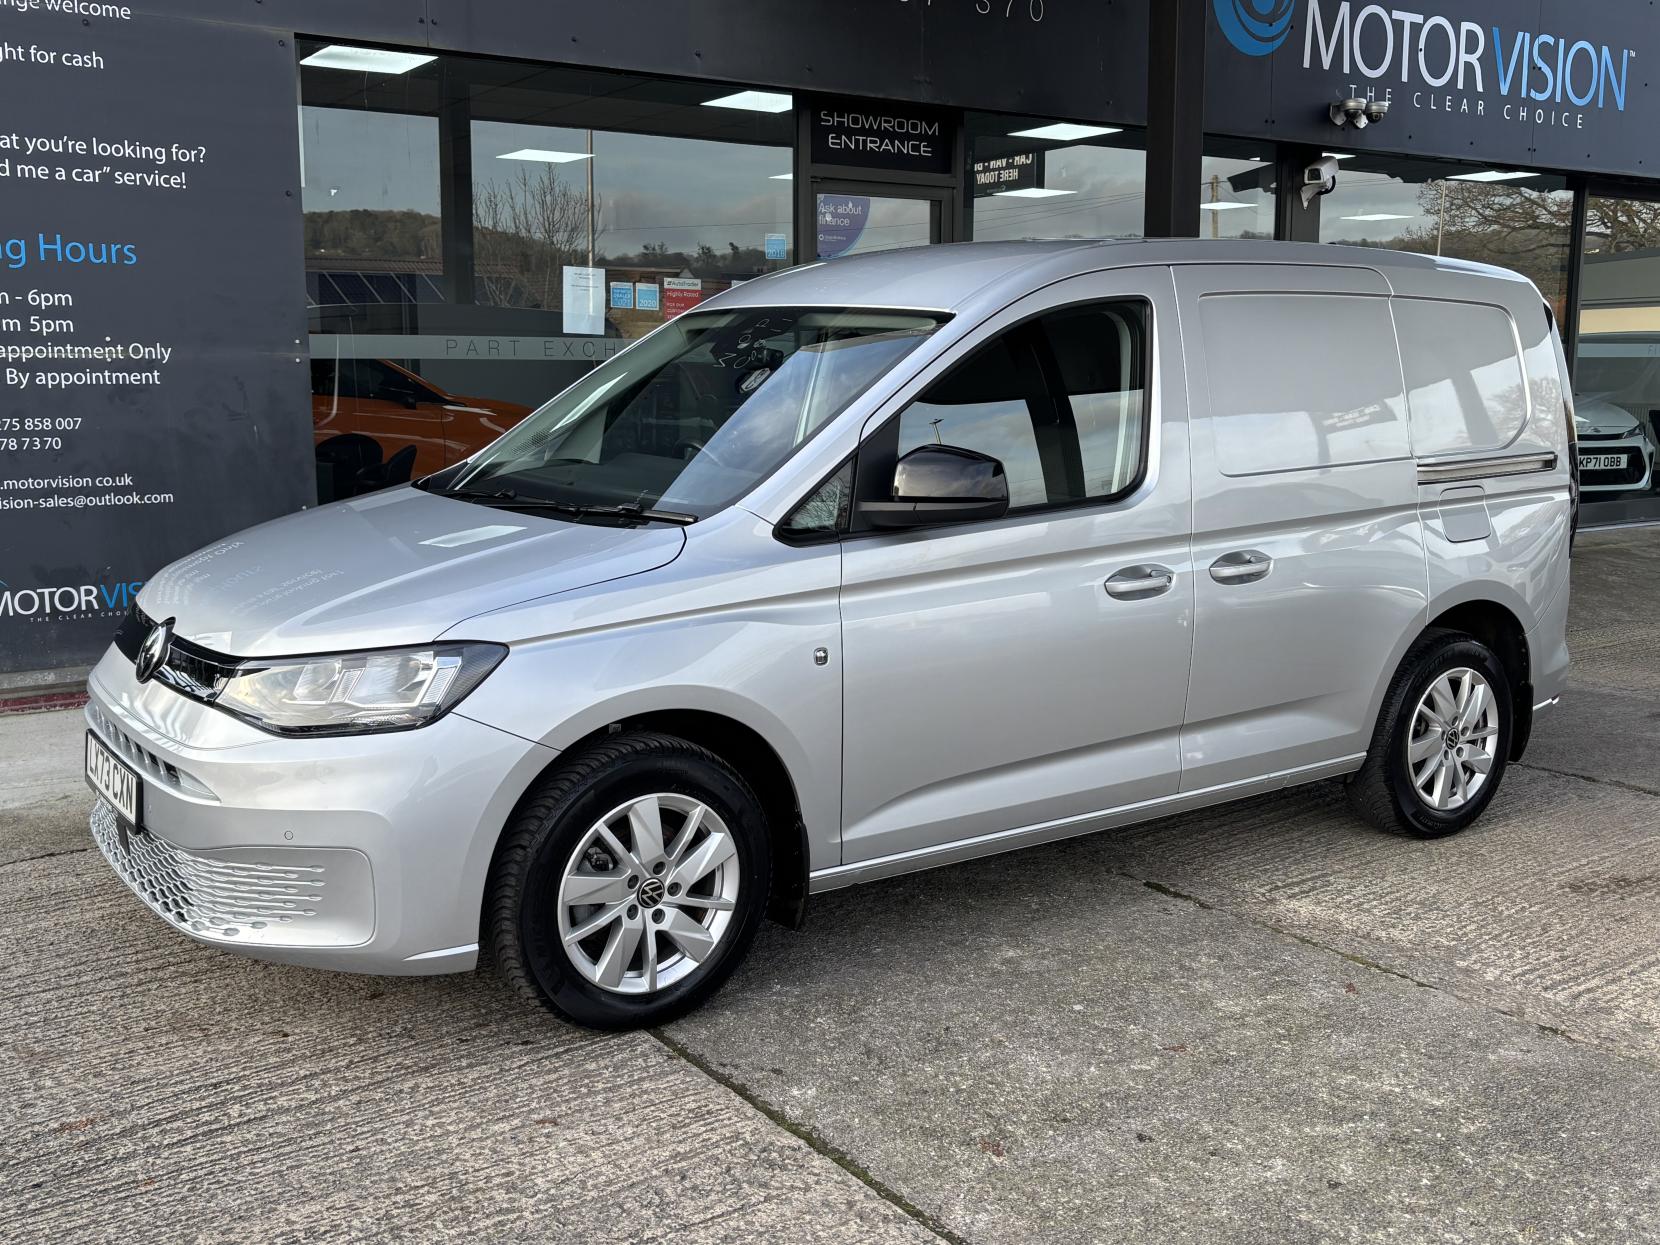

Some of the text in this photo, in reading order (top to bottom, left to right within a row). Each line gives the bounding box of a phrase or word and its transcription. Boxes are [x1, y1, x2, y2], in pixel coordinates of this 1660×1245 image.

[45, 0, 131, 19] welcome
[0, 41, 104, 69] ht for cash
[1413, 92, 1485, 116] CLEAR
[1503, 104, 1583, 129] CHOICE
[820, 110, 939, 136] SHOWROOM
[24, 136, 87, 155] you’re
[92, 137, 166, 164] looking
[171, 144, 206, 163] for?
[828, 133, 933, 157] ENTRANCE
[17, 164, 49, 179] me
[55, 167, 66, 180] a
[114, 170, 187, 189] service!
[818, 201, 862, 215] Ask about
[38, 233, 137, 265] Hours
[28, 289, 73, 310] 6pm
[29, 316, 74, 336] 5pm
[0, 342, 171, 364] appointment Only
[445, 339, 616, 357] PART EXCH
[6, 368, 161, 389] By appointment
[0, 417, 82, 431] 75 858 007
[1579, 456, 1601, 468] KP71
[58, 612, 93, 621] CLEAR
[89, 737, 134, 815] LX73 CXN
